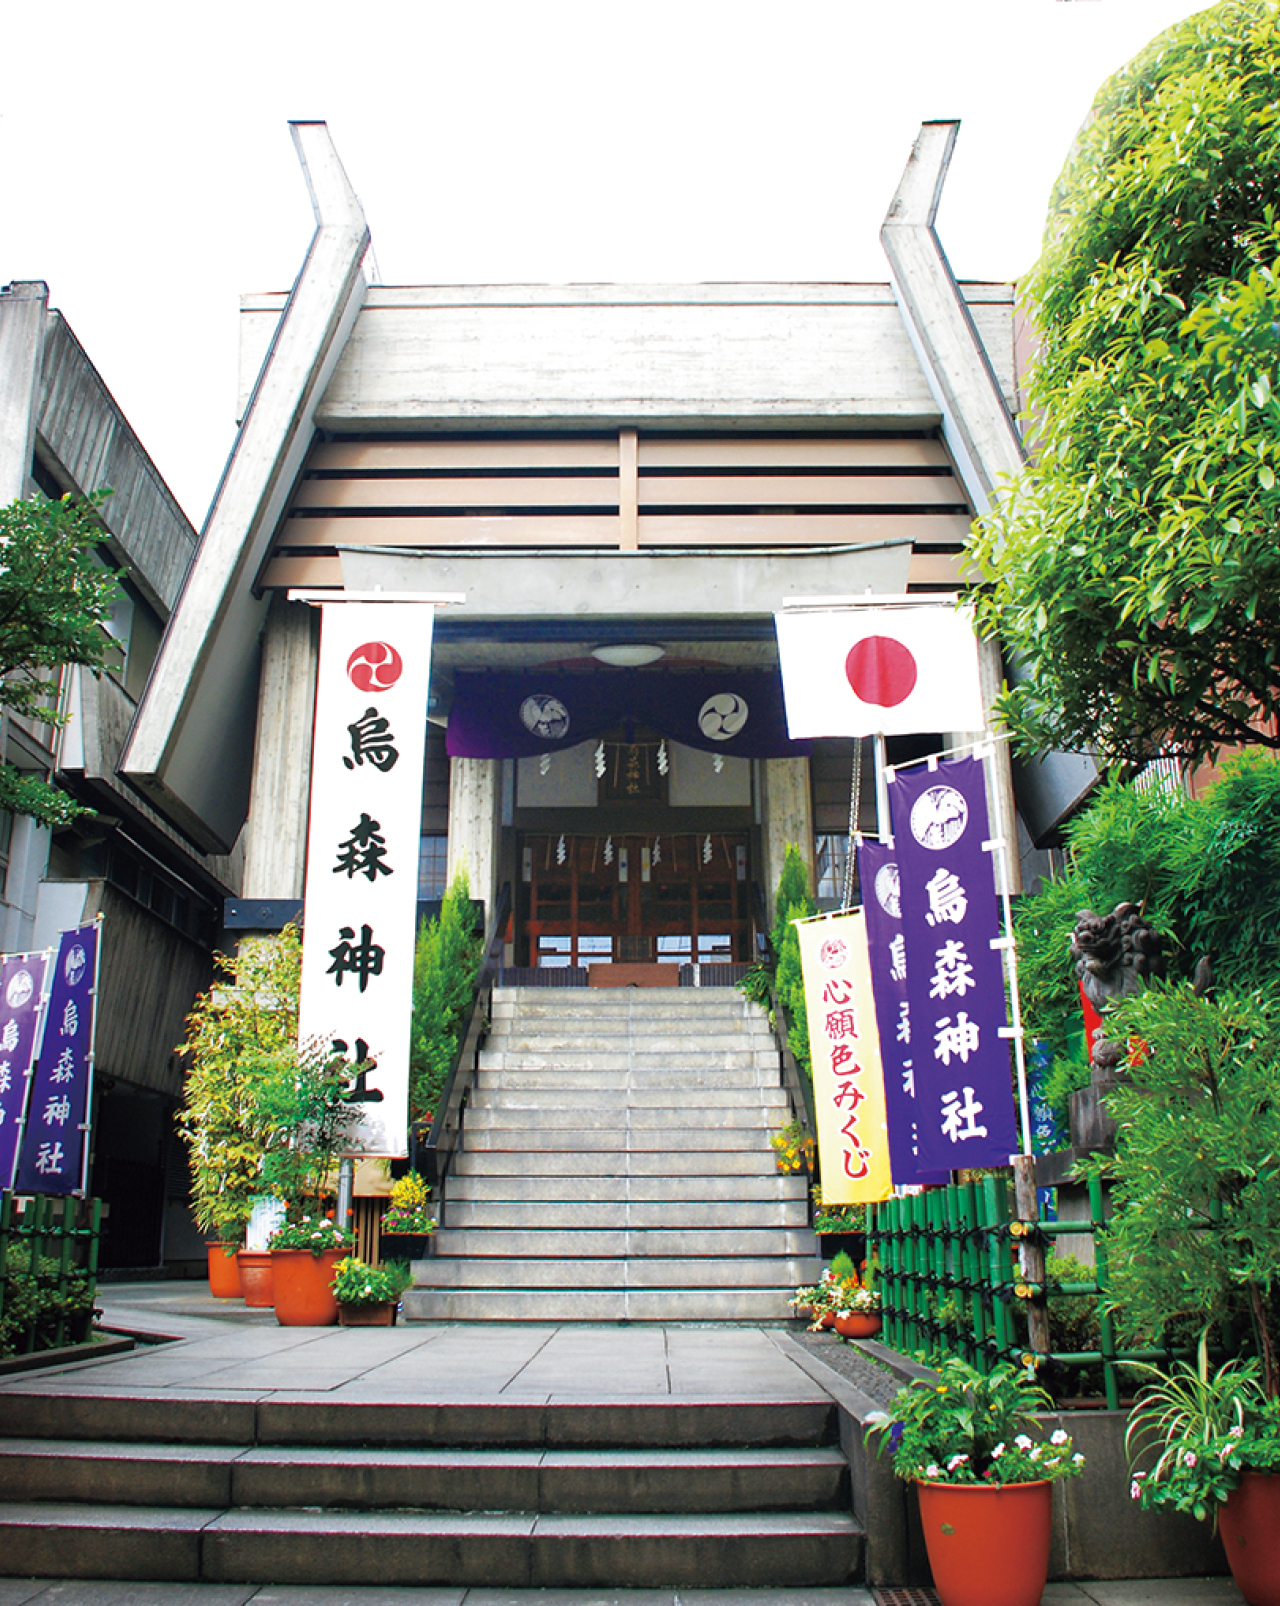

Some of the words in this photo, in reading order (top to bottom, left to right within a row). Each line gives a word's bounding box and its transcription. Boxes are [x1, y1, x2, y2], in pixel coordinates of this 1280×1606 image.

[35, 999, 79, 1175] 烏森神社
[822, 977, 869, 1180] 心願色みくじ
[925, 867, 988, 1143] 烏森神社
